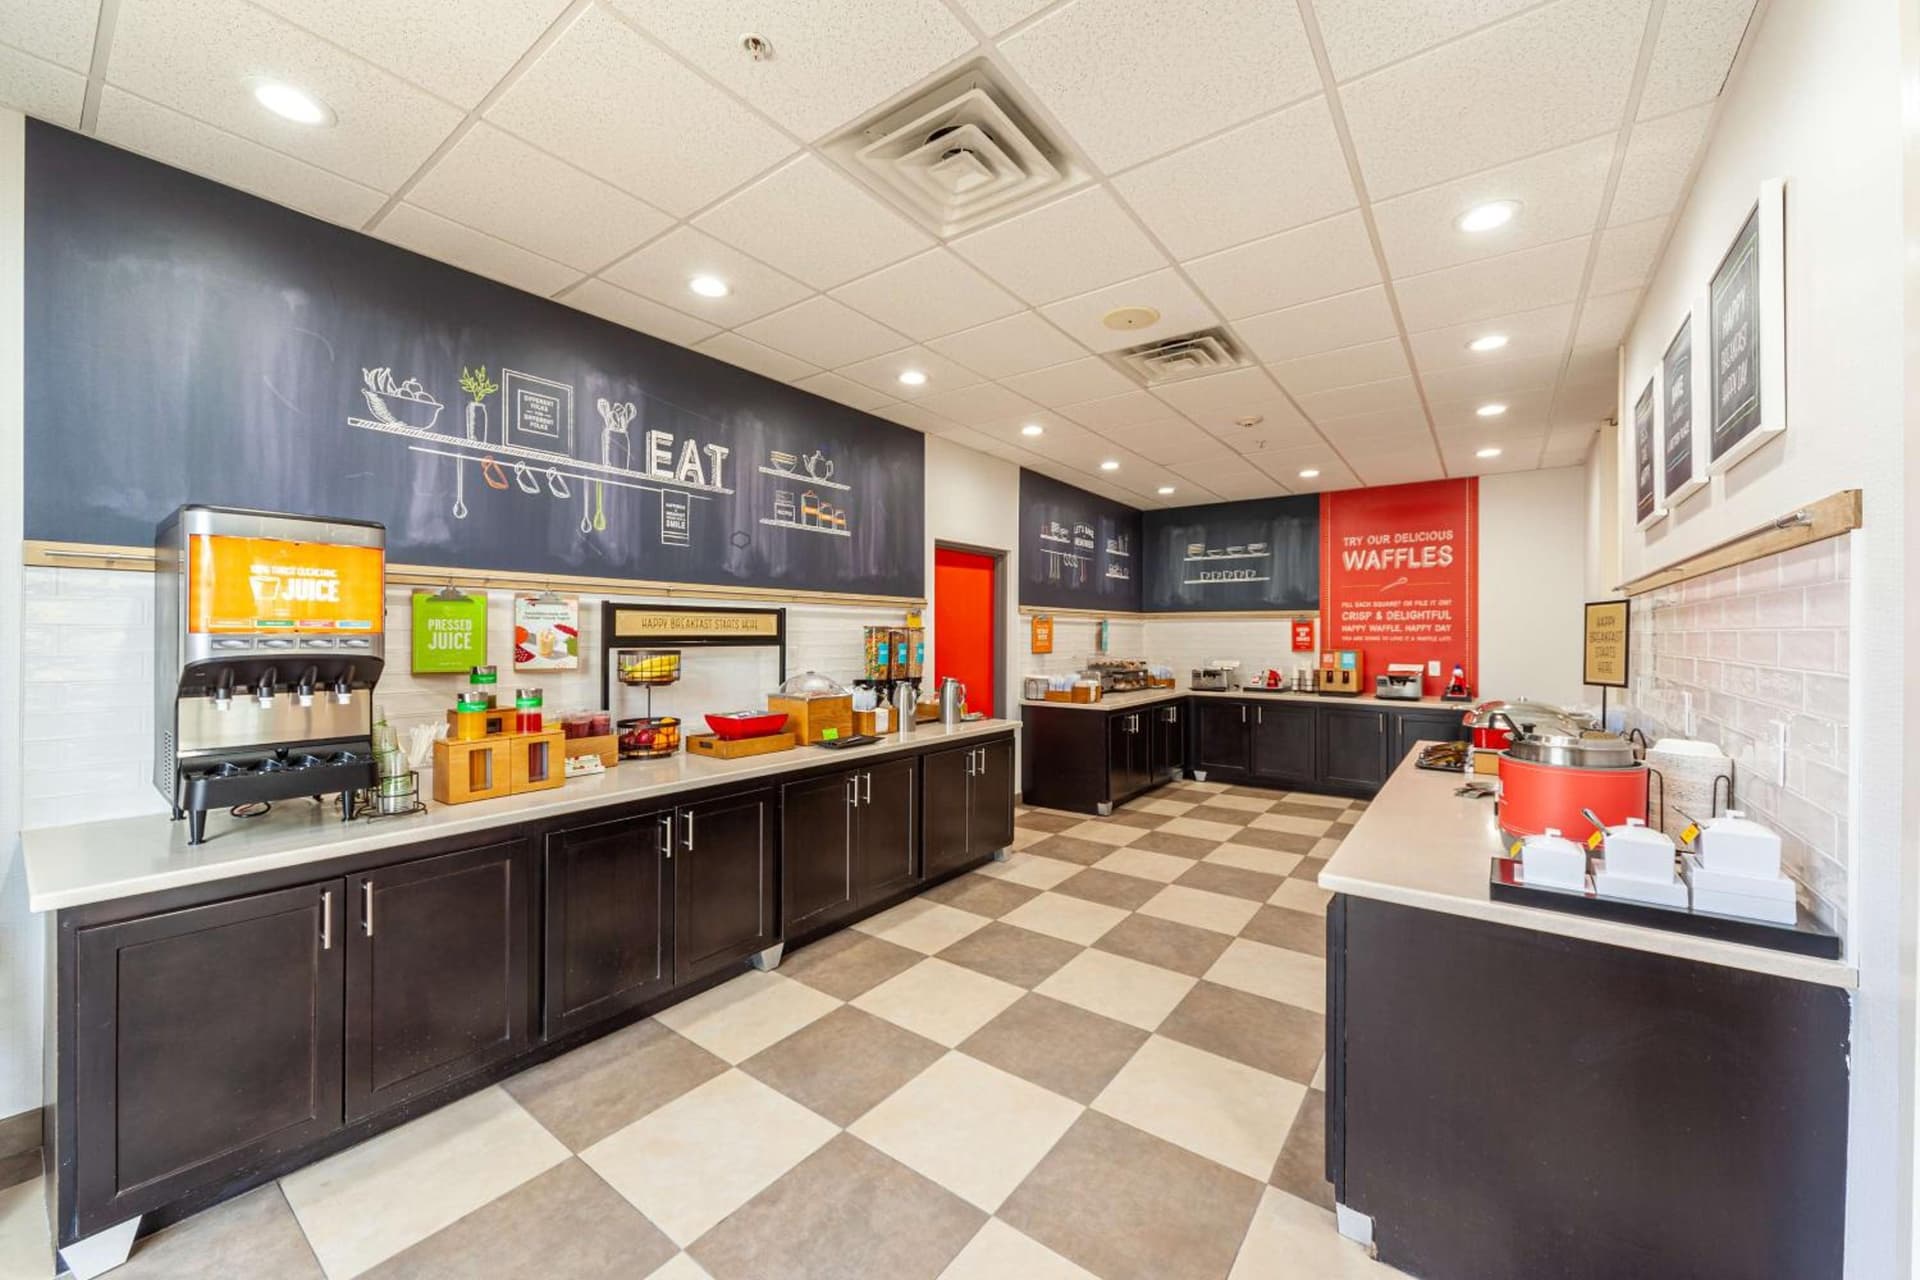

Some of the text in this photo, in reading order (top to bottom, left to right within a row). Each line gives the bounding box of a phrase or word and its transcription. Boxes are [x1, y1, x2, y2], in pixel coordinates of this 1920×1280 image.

[646, 430, 730, 488] EAT
[1343, 530, 1454, 547] TRY OUR DELICIOUS
[1342, 544, 1454, 572] WAFFLES
[281, 578, 340, 603] JUICE
[641, 616, 667, 629] HAPPY
[670, 616, 712, 630] BREAKFAST
[1341, 610, 1453, 621] CRISP & DELIGHTFUL
[428, 618, 472, 631] PRESSED
[1341, 625, 1367, 633] HAPPY
[1405, 624, 1432, 632] HAPPY
[428, 632, 473, 650] JUICE
